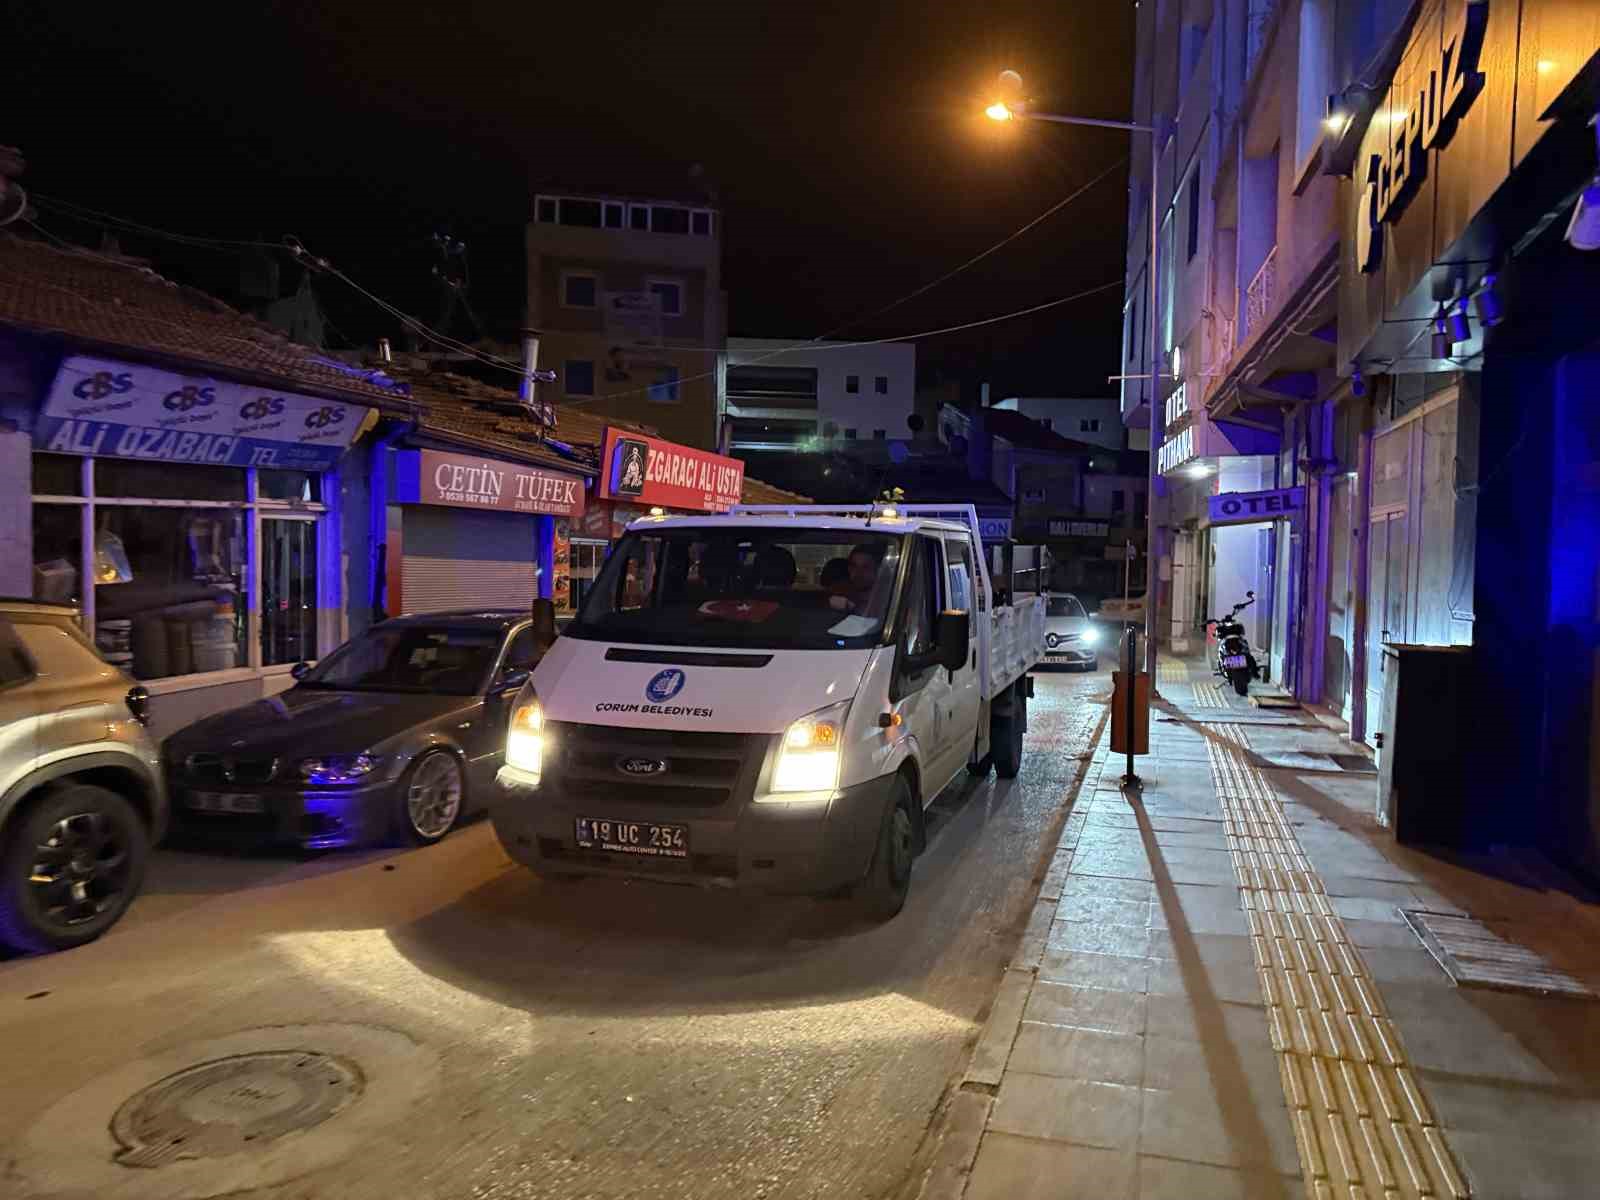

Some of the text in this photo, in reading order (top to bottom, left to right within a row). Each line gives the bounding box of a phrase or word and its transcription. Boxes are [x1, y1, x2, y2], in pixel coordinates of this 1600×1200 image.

[72, 371, 135, 400] CBS
[163, 385, 217, 413] CBS
[239, 396, 286, 421] CBS
[1165, 381, 1188, 427] OTEL
[304, 406, 346, 431] CBS
[434, 463, 577, 505] ÇETİN TÜFEK
[645, 449, 698, 489] ZGARACI
[717, 465, 741, 497] USTA
[1221, 494, 1299, 515] OTEL
[591, 821, 683, 848] 19 UC 254
